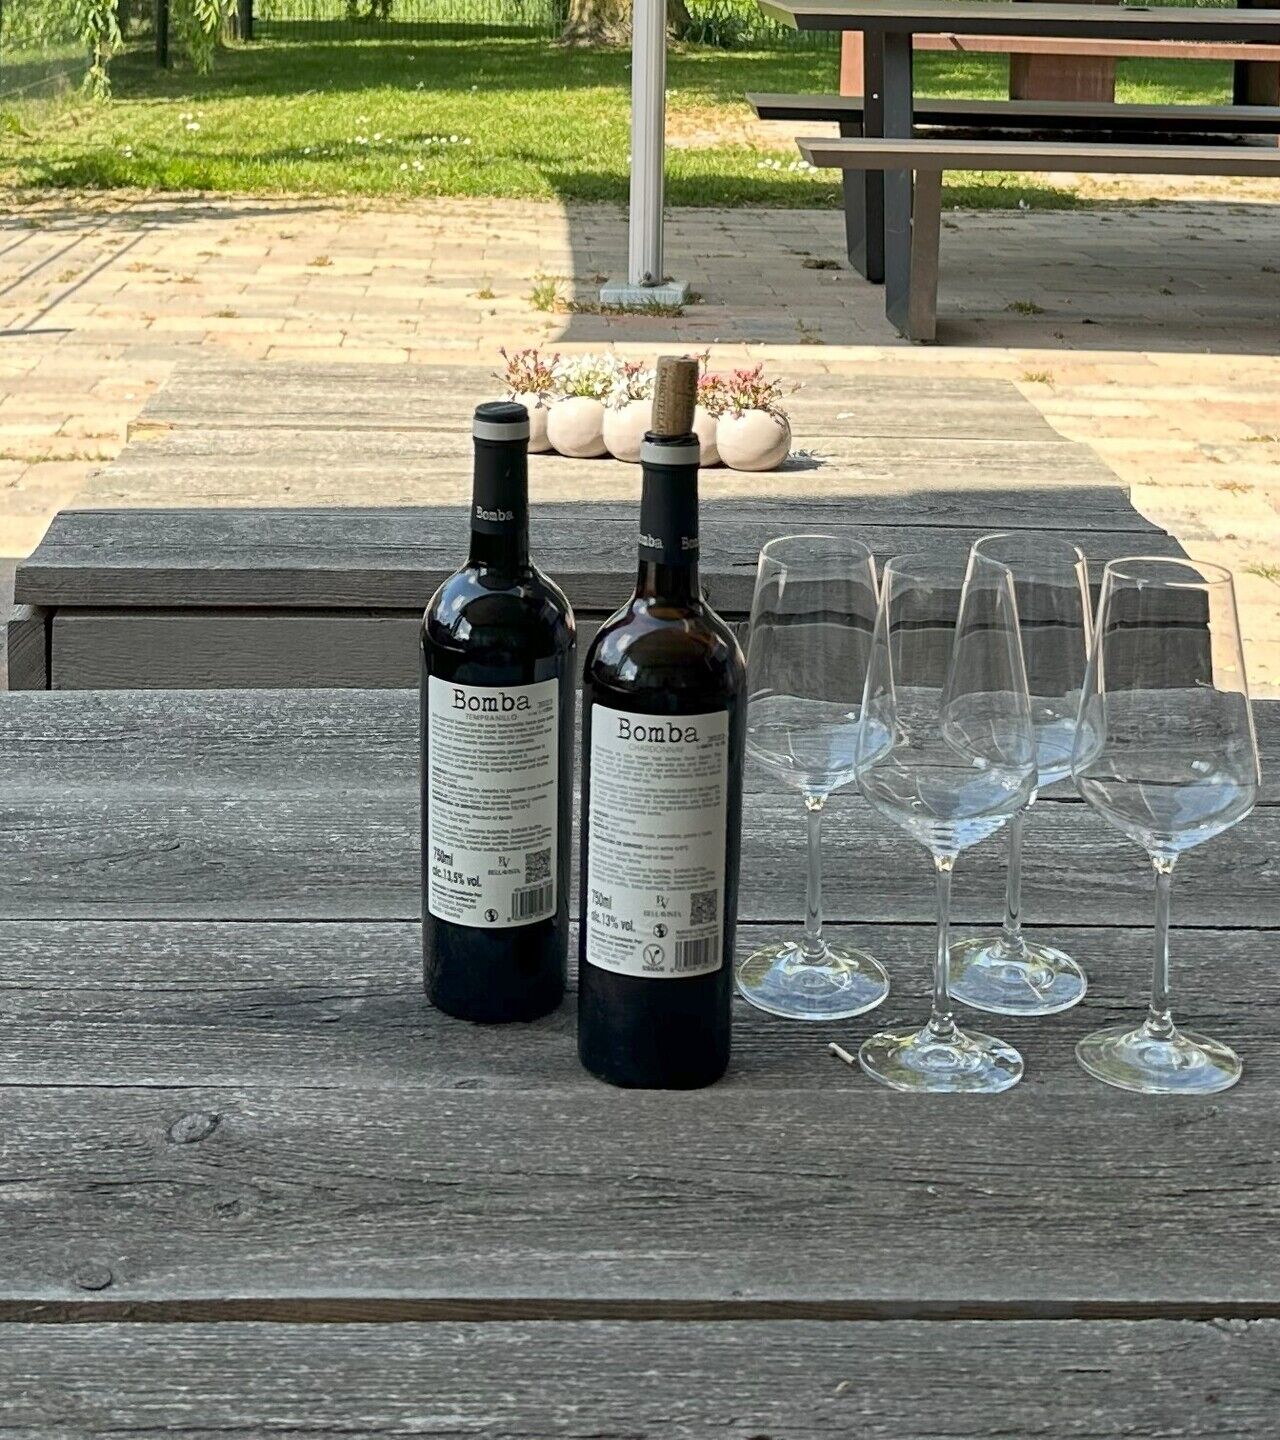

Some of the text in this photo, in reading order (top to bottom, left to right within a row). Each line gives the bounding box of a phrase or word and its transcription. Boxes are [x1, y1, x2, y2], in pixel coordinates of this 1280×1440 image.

[475, 505, 514, 522] Bomba
[639, 533, 664, 549] mba
[452, 688, 531, 712] Bomba
[617, 717, 700, 743] Bomba
[628, 744, 684, 753] CHARDONNAY
[433, 846, 453, 867] 750ml
[467, 875, 482, 887] vol.
[591, 888, 612, 910] 750ml
[621, 920, 636, 932] vol.
